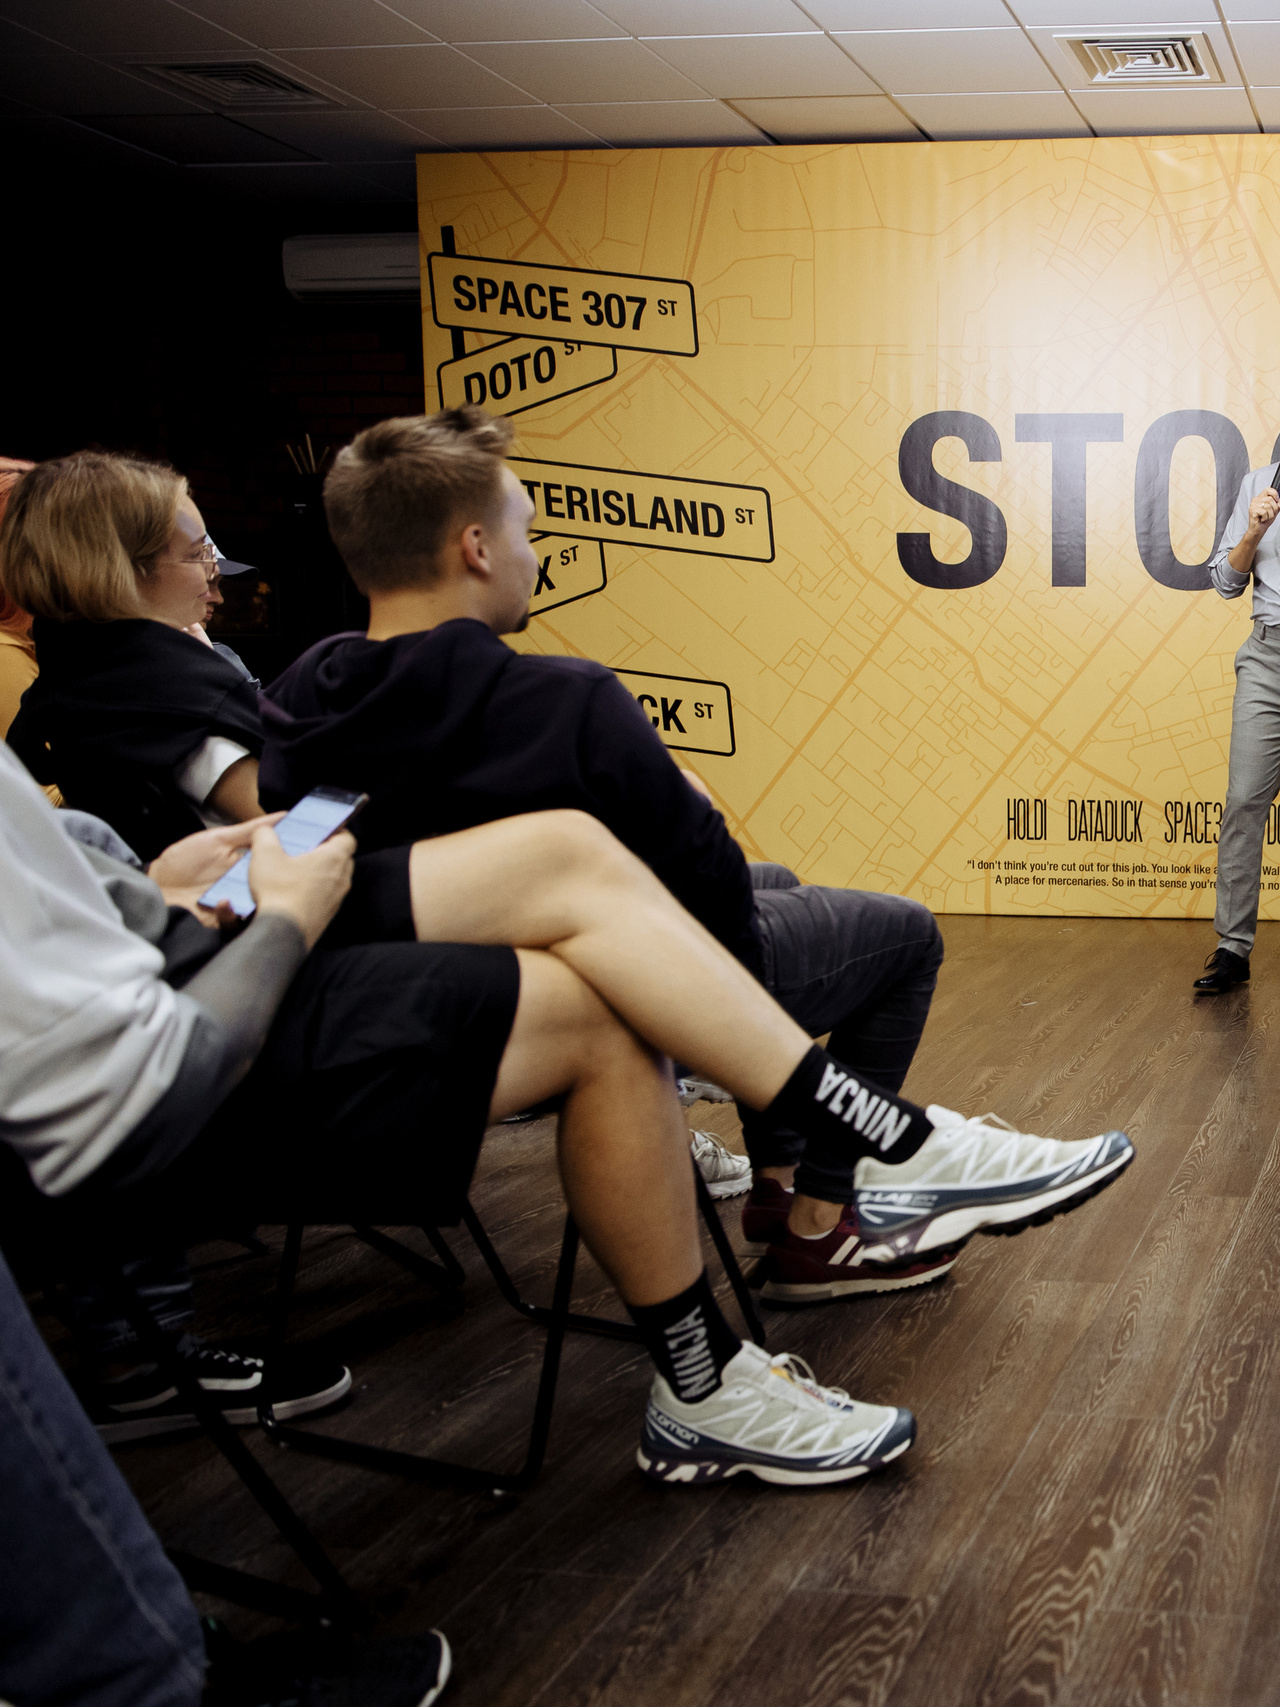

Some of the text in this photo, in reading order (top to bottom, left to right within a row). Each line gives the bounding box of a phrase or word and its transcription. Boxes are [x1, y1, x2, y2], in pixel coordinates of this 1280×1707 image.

[452, 274, 678, 331] SPACE 307 ST
[463, 345, 557, 407] DOTO
[734, 507, 756, 526] ST
[560, 544, 580, 567] ST
[693, 701, 715, 720] ST
[1006, 798, 1048, 841] HOLDI
[1068, 799, 1144, 843] DATADUCK
[1164, 801, 1224, 844] SPACE3
[977, 859, 1002, 871] don't
[1003, 860, 1028, 872] think
[1029, 861, 1059, 873] you're
[1061, 862, 1077, 872] cut
[1078, 862, 1095, 872] out
[1096, 862, 1110, 873] for
[1112, 862, 1130, 873] this
[1131, 862, 1150, 875] job.
[1151, 863, 1169, 874] You
[1171, 864, 1192, 874] look
[1193, 864, 1212, 875] like
[994, 874, 1003, 885] A
[1004, 874, 1030, 887] place
[1032, 875, 1046, 886] for
[1048, 876, 1110, 887] mercenaries.
[1111, 876, 1125, 888] So
[1126, 877, 1136, 888] in
[1138, 878, 1158, 888] that
[1159, 879, 1188, 889] sense
[1189, 879, 1218, 891] you're
[814, 1061, 913, 1153] NINJA
[663, 1303, 718, 1399] NINJA
